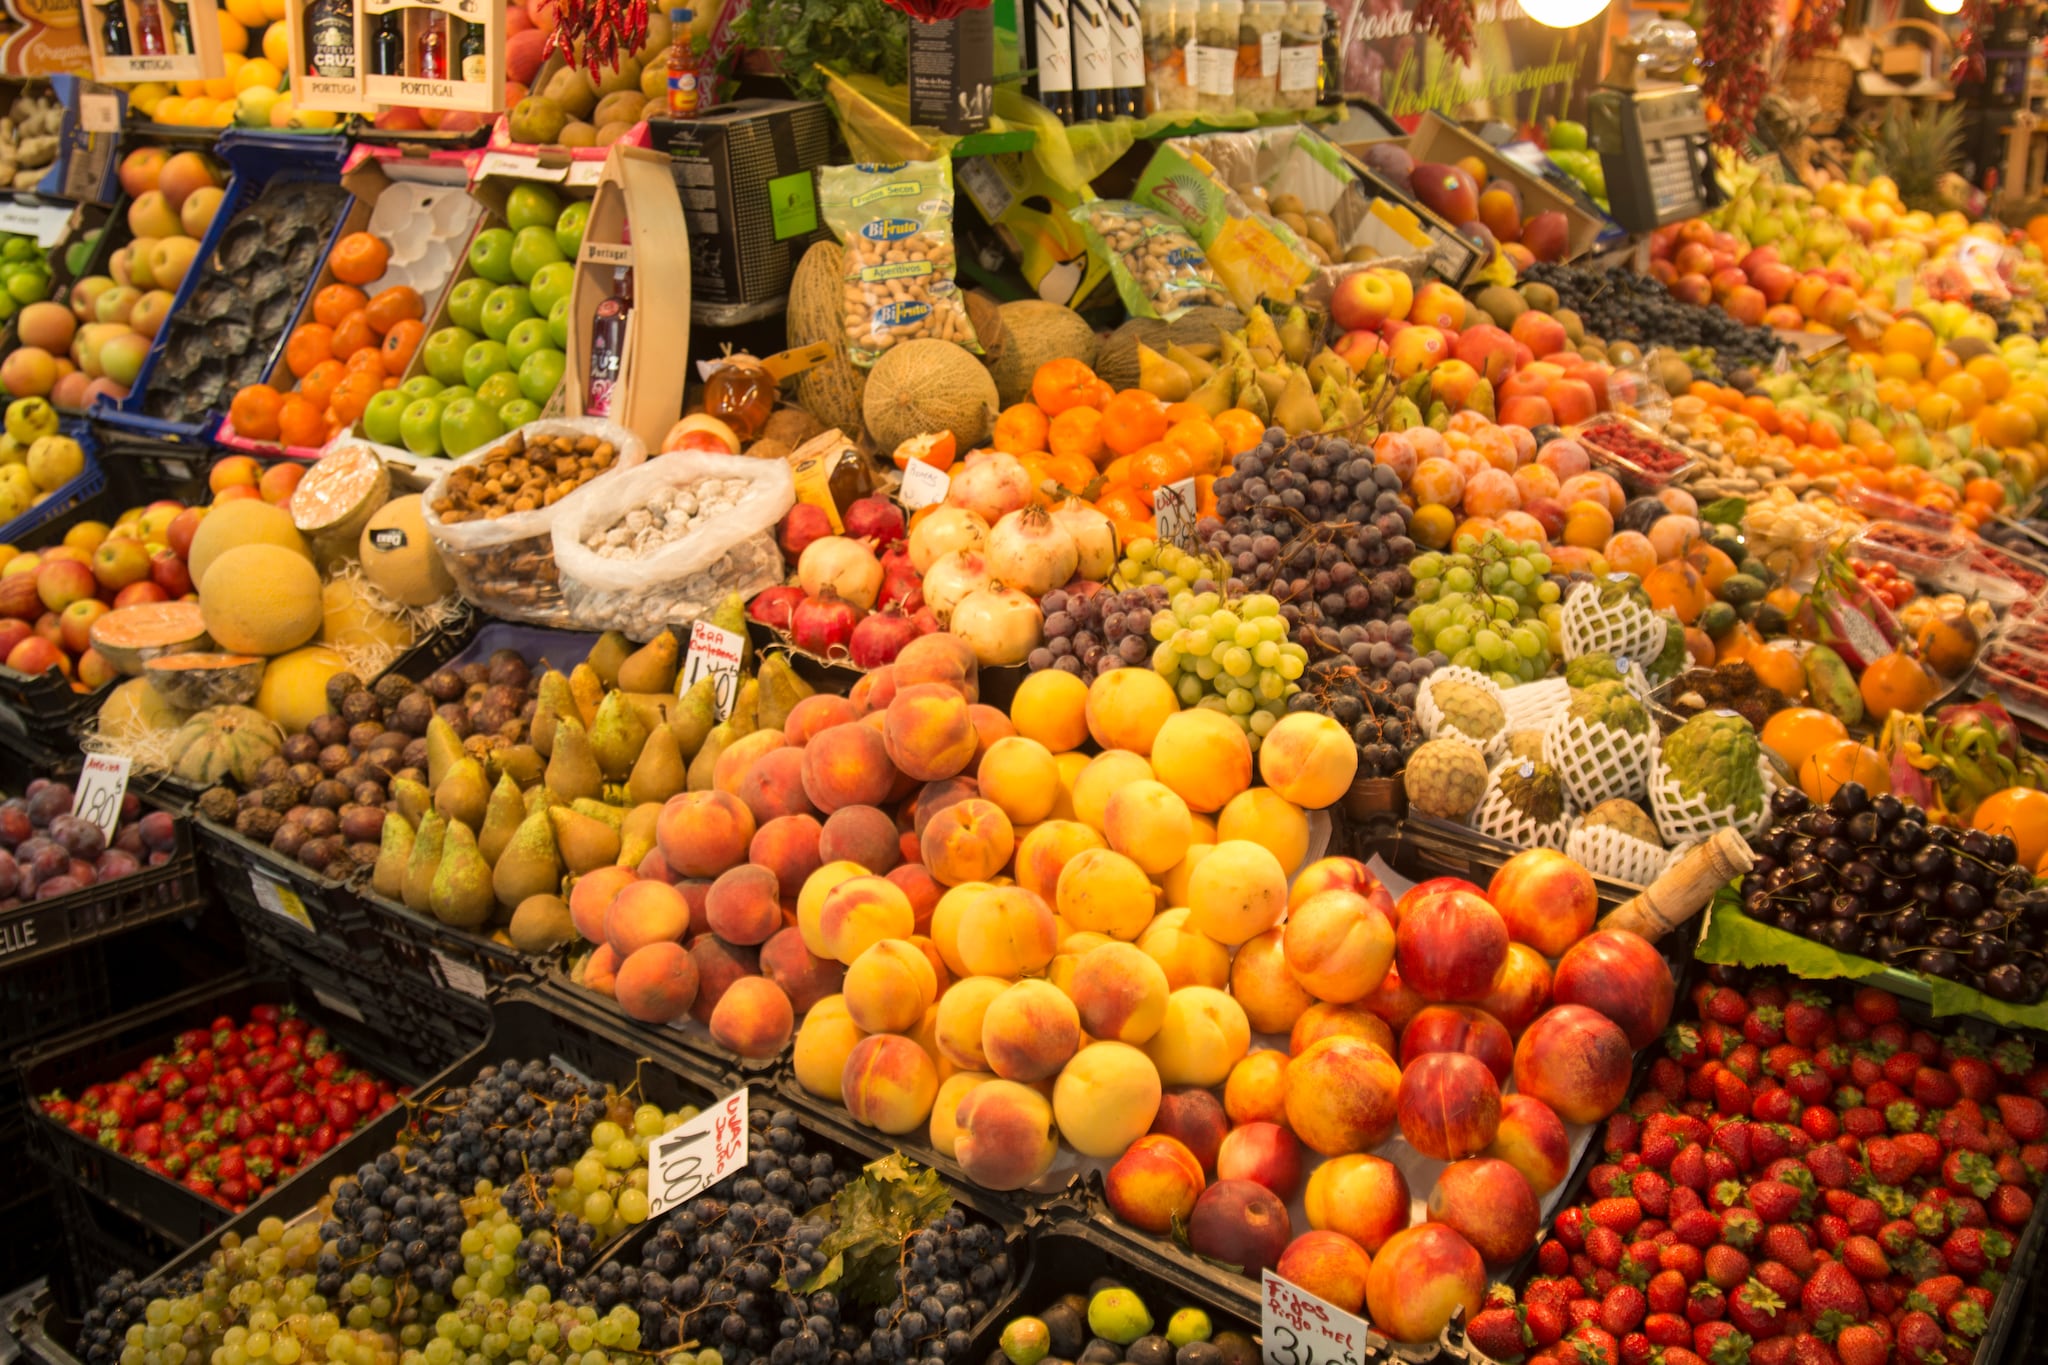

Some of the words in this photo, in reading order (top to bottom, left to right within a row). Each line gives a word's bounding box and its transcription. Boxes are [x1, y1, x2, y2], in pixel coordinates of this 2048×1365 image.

[130, 60, 173, 71] PORTUGAL
[313, 54, 354, 67] CRUZ
[312, 82, 356, 95] PORTUGA
[401, 82, 453, 97] PORTUGAL
[887, 184, 915, 196] Secos
[868, 219, 917, 240] BiFruta
[589, 246, 628, 261] Portugal
[873, 263, 922, 278] Aperitivos
[881, 301, 928, 324] BiFruta
